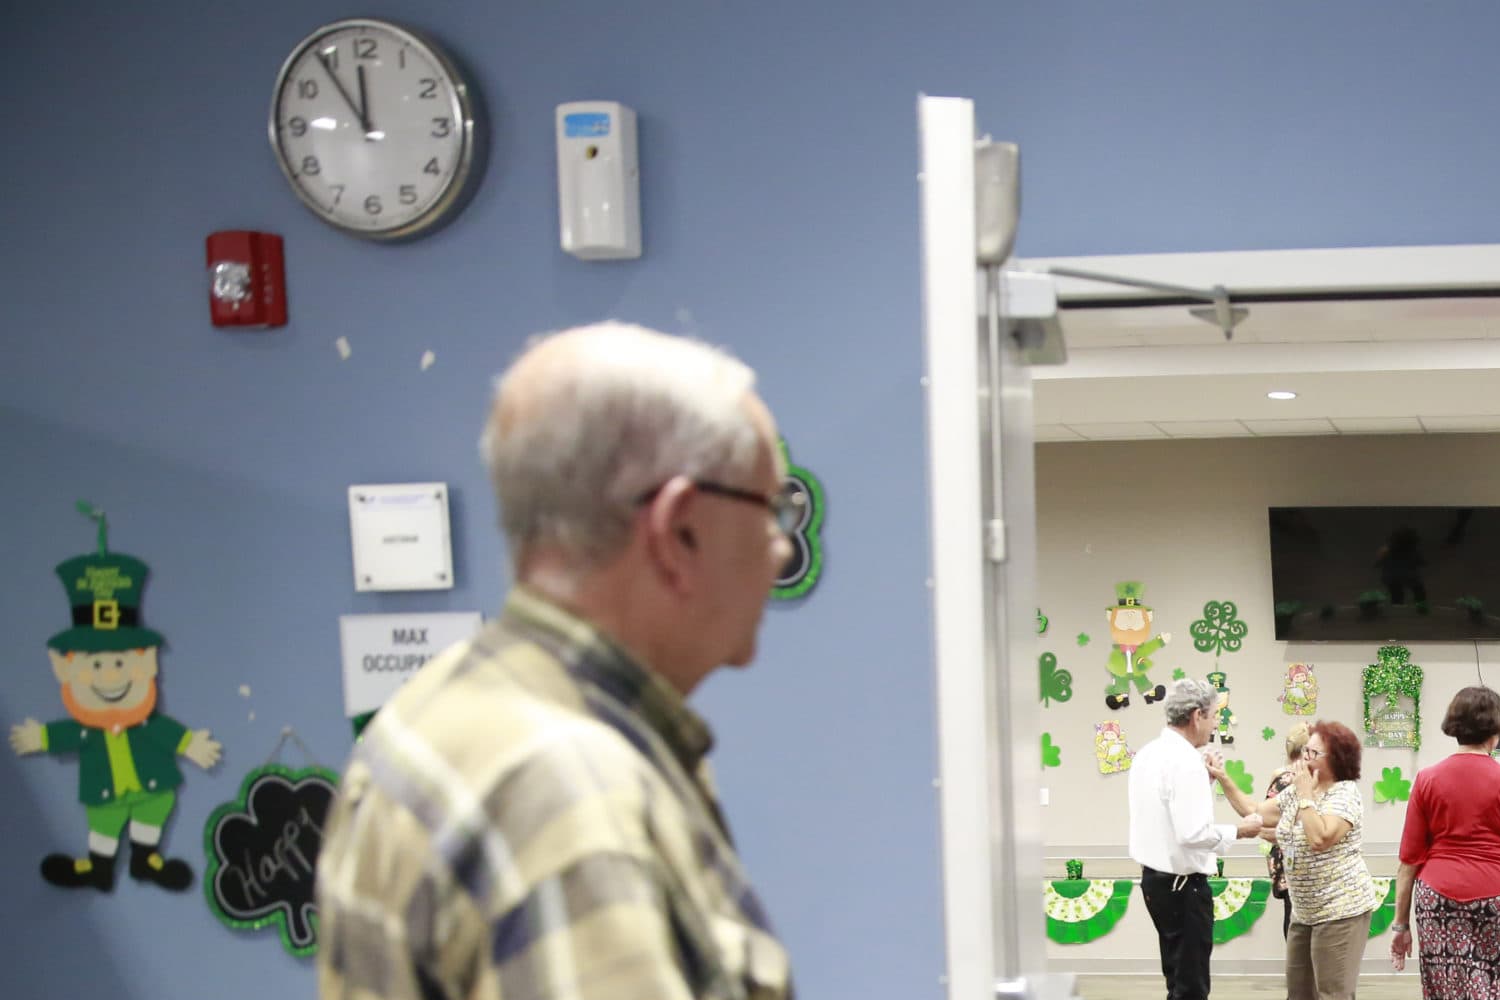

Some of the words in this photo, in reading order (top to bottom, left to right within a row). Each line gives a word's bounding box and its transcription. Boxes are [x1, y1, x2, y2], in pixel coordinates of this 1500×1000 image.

[353, 39, 377, 60] 12
[400, 50, 406, 69] 1
[299, 79, 319, 99] 10
[419, 79, 438, 99] 2
[289, 117, 307, 137] 9
[431, 118, 449, 138] 3
[302, 155, 321, 176] 8
[423, 157, 441, 176] 4
[329, 185, 345, 205] 7
[364, 195, 383, 215] 6
[400, 185, 417, 205] 5
[392, 629, 429, 645] MAX
[362, 655, 434, 673] OCCUPA
